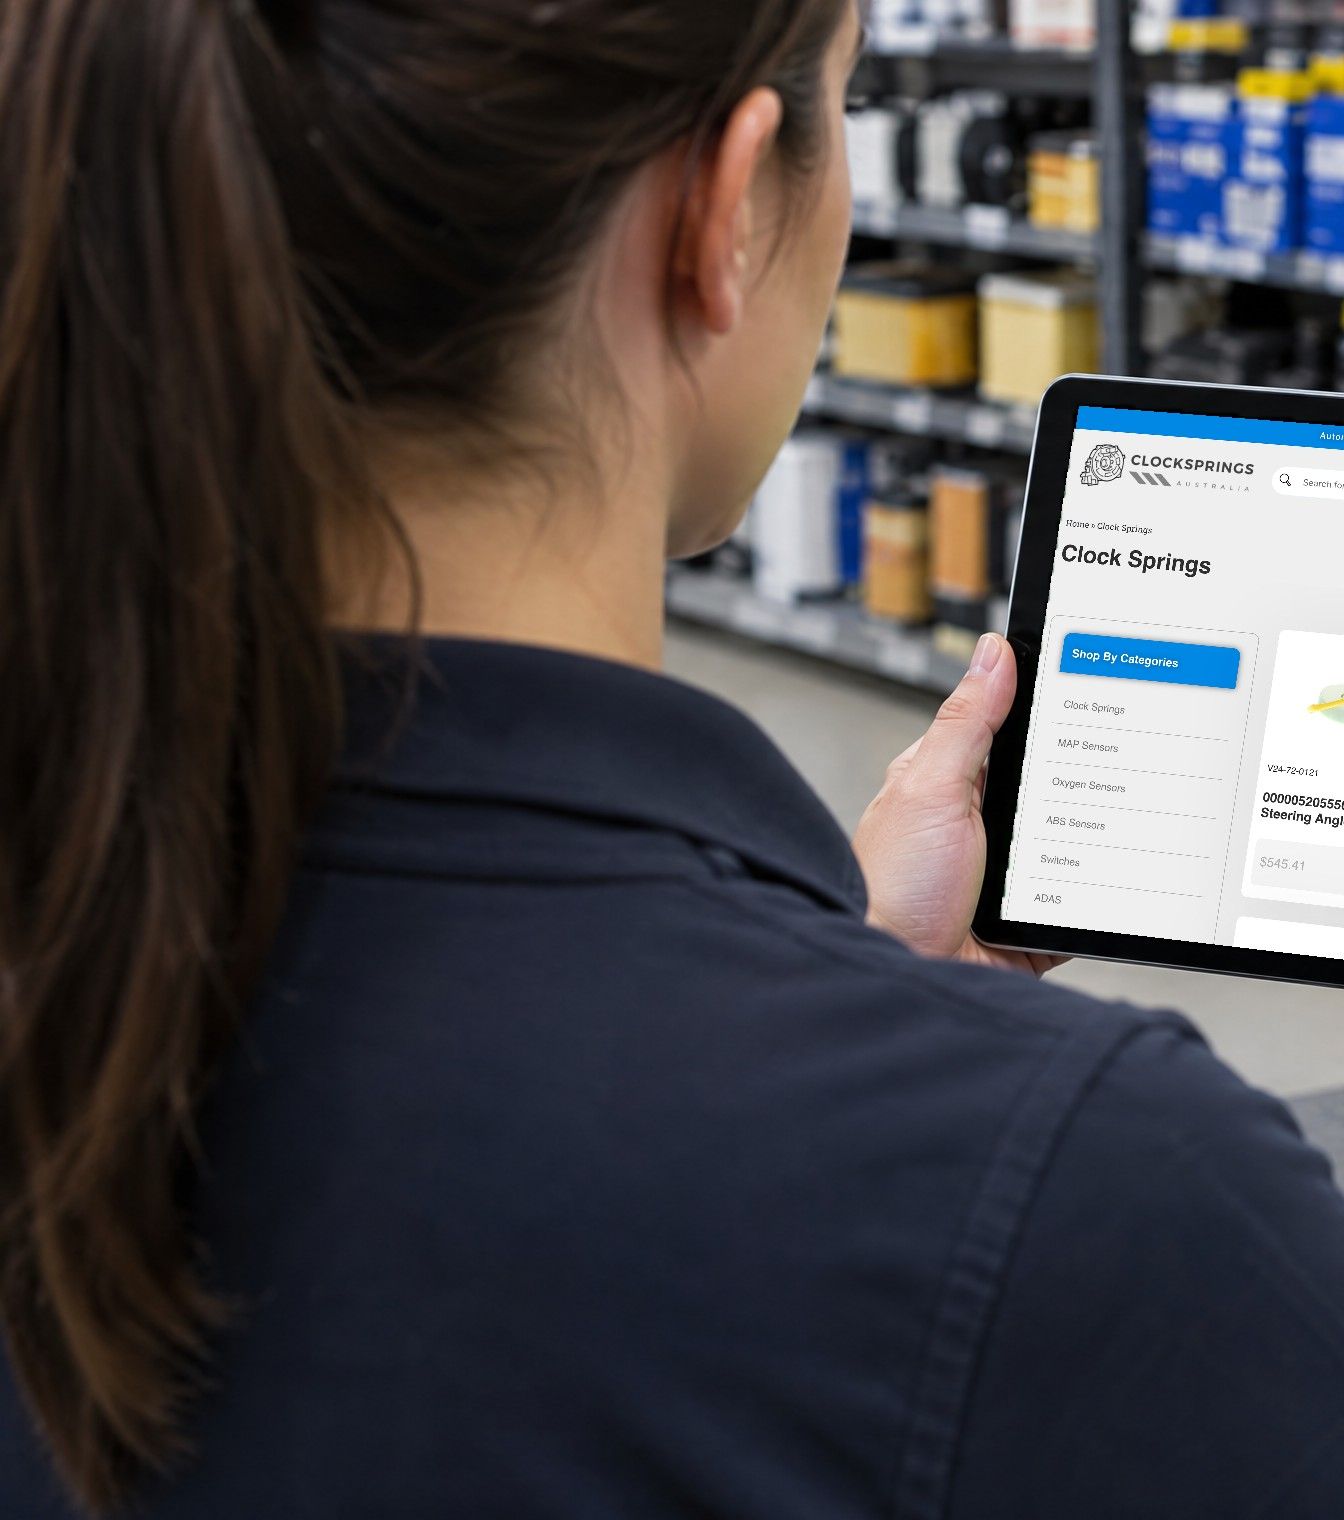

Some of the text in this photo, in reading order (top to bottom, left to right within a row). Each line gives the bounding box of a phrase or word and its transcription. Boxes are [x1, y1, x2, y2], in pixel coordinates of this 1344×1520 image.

[1131, 454, 1255, 475] CLOCKSPRINGS
[1176, 480, 1250, 492] AUSTRALIA
[1303, 478, 1332, 489] Search
[1334, 481, 1344, 490] for
[1065, 519, 1090, 529] Home
[1097, 522, 1120, 532] Clock
[1121, 524, 1153, 536] Springs
[1061, 544, 1211, 578] Clock Springs
[1071, 648, 1179, 670] Shop By Categories
[1063, 699, 1126, 716] Clock Springs
[1057, 738, 1119, 753] MAP Sensors
[1267, 764, 1319, 777] V24-72-0121
[1052, 777, 1126, 793] Oxygen Sensors
[1045, 815, 1106, 831] ABS Sensors
[1260, 807, 1312, 825] Steering
[1040, 854, 1080, 867] Switches
[1259, 856, 1305, 872] $545.41
[1033, 893, 1062, 905] ADAS
